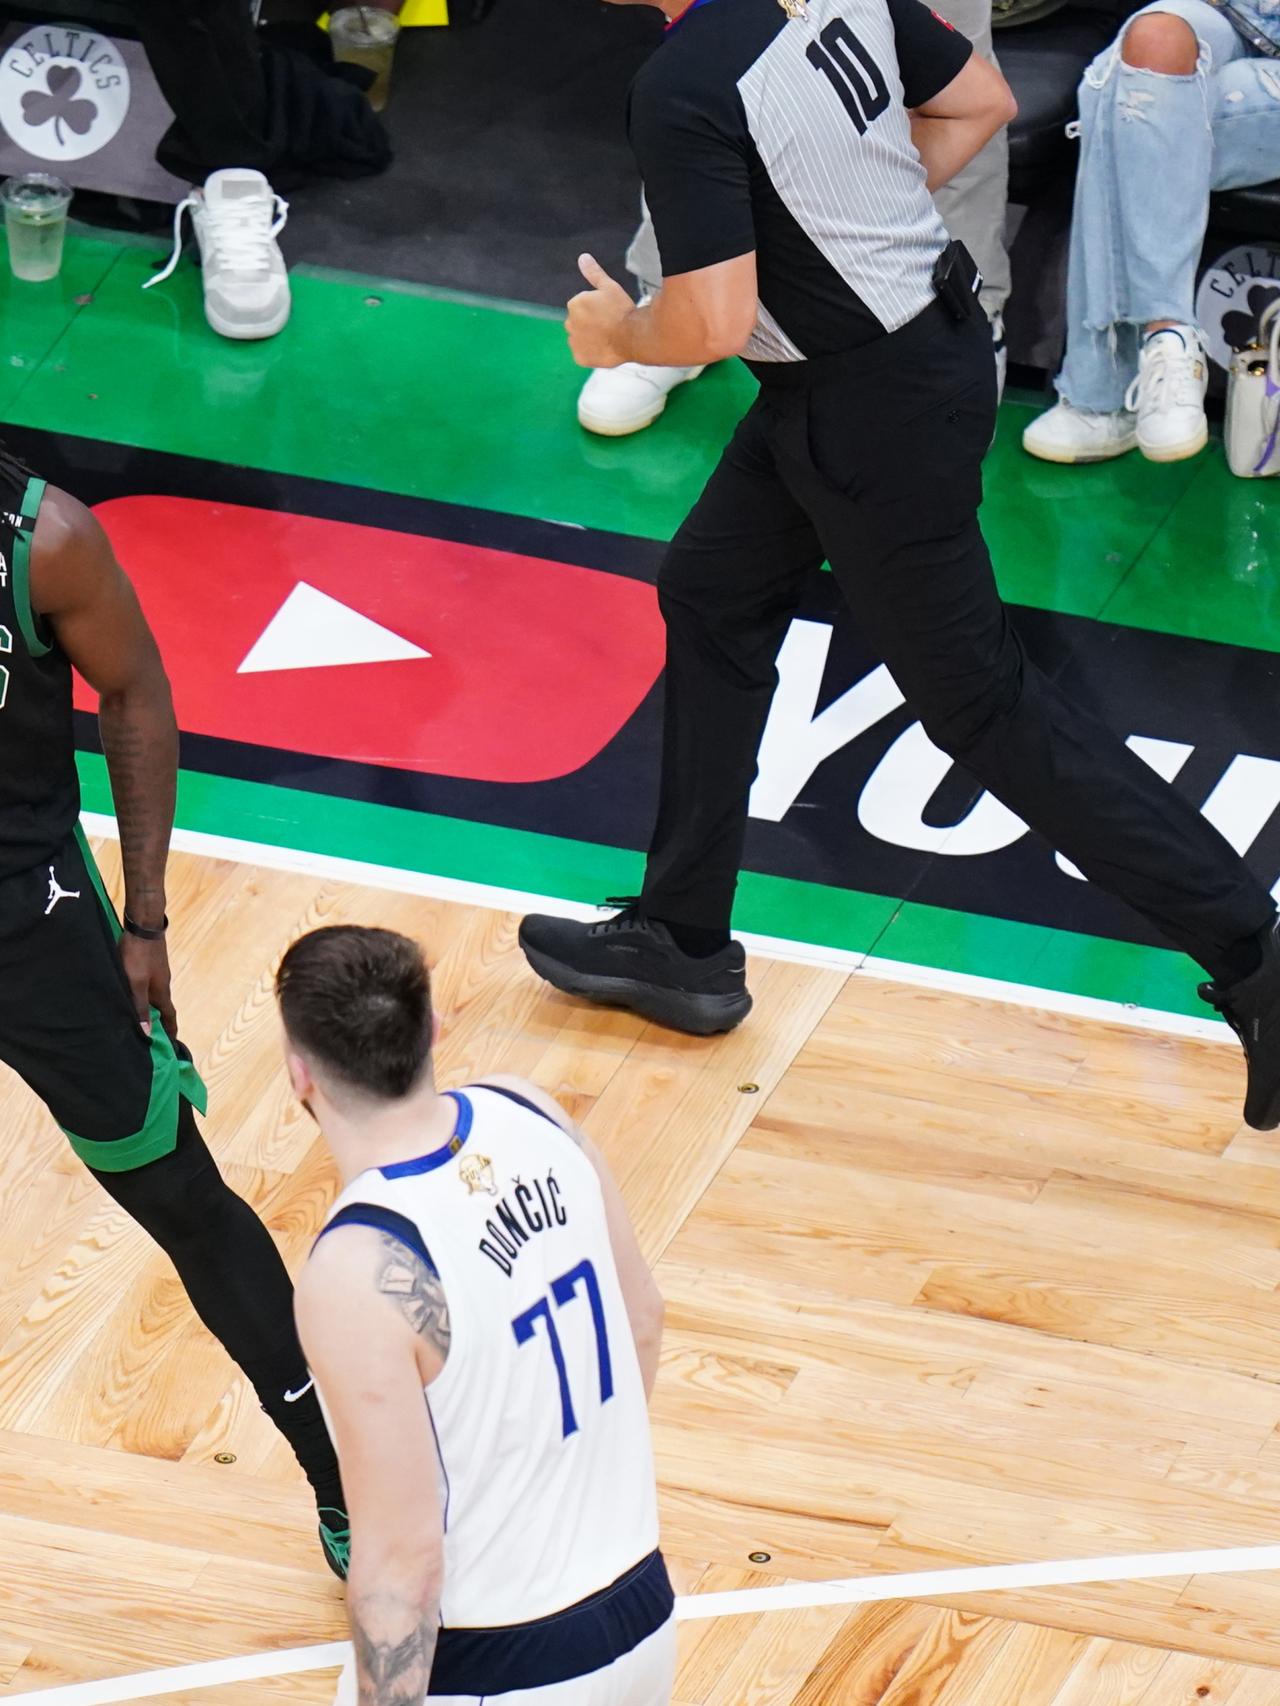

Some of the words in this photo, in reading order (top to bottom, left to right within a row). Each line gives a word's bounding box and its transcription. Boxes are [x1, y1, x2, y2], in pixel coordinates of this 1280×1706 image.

[9, 31, 121, 90] CELTICS
[805, 17, 891, 137] 10
[478, 1167, 567, 1279] DONČIĆ
[511, 1258, 614, 1440] 77
